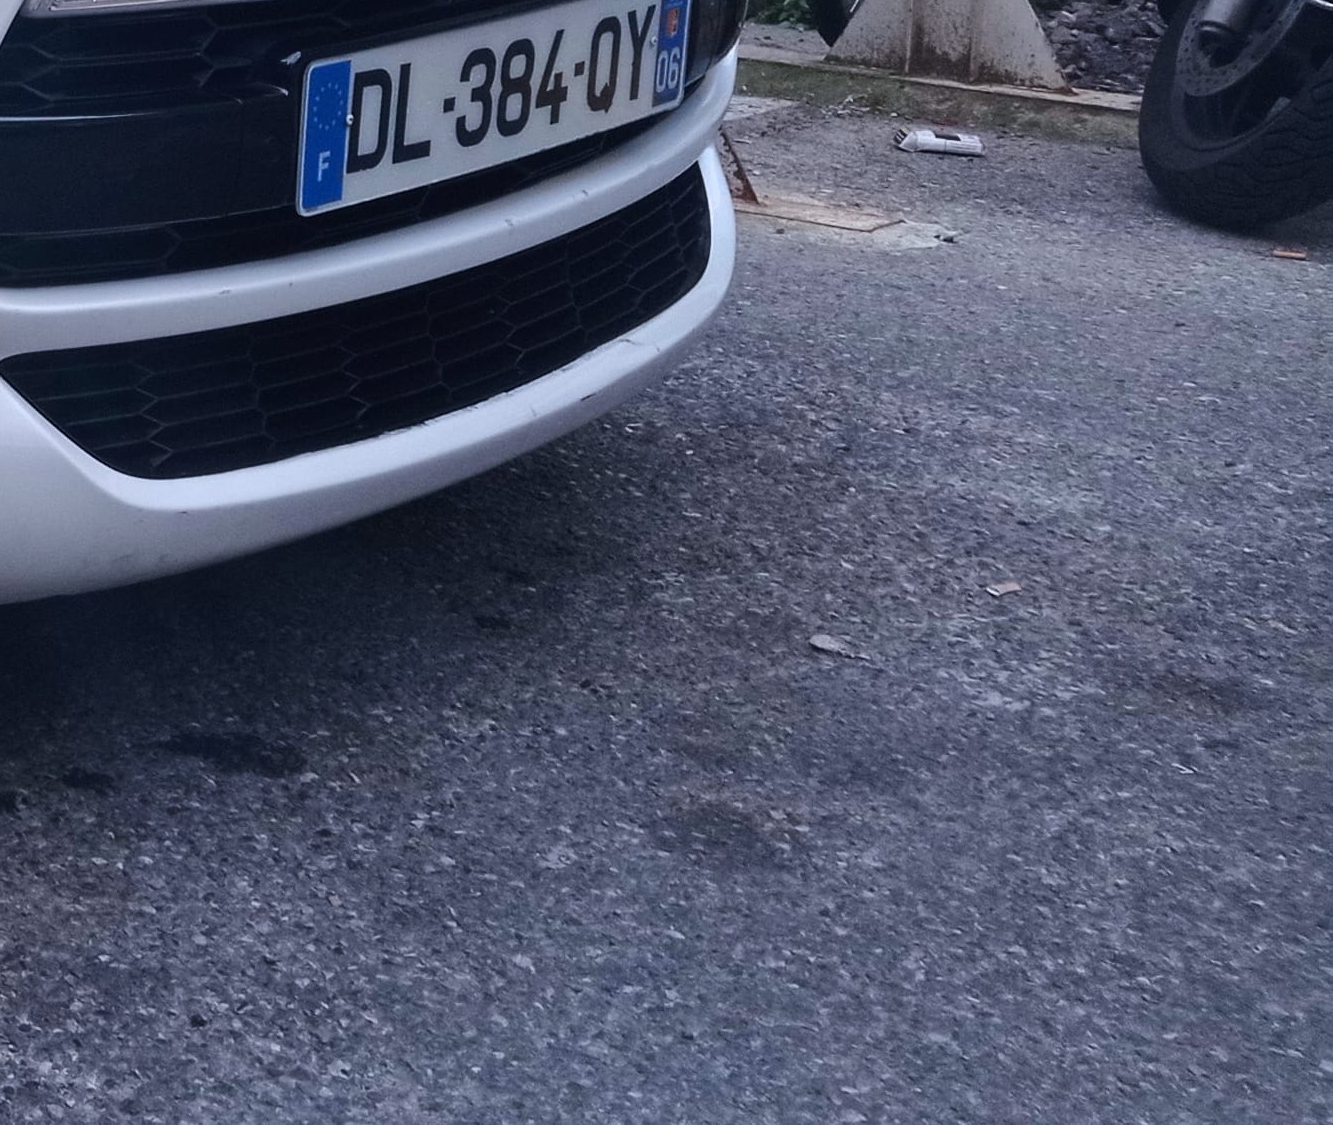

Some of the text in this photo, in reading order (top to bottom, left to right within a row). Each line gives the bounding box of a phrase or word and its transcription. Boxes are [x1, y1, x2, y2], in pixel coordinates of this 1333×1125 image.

[346, 4, 657, 174] DL-384-QY
[656, 46, 681, 93] 06
[317, 150, 331, 182] F
